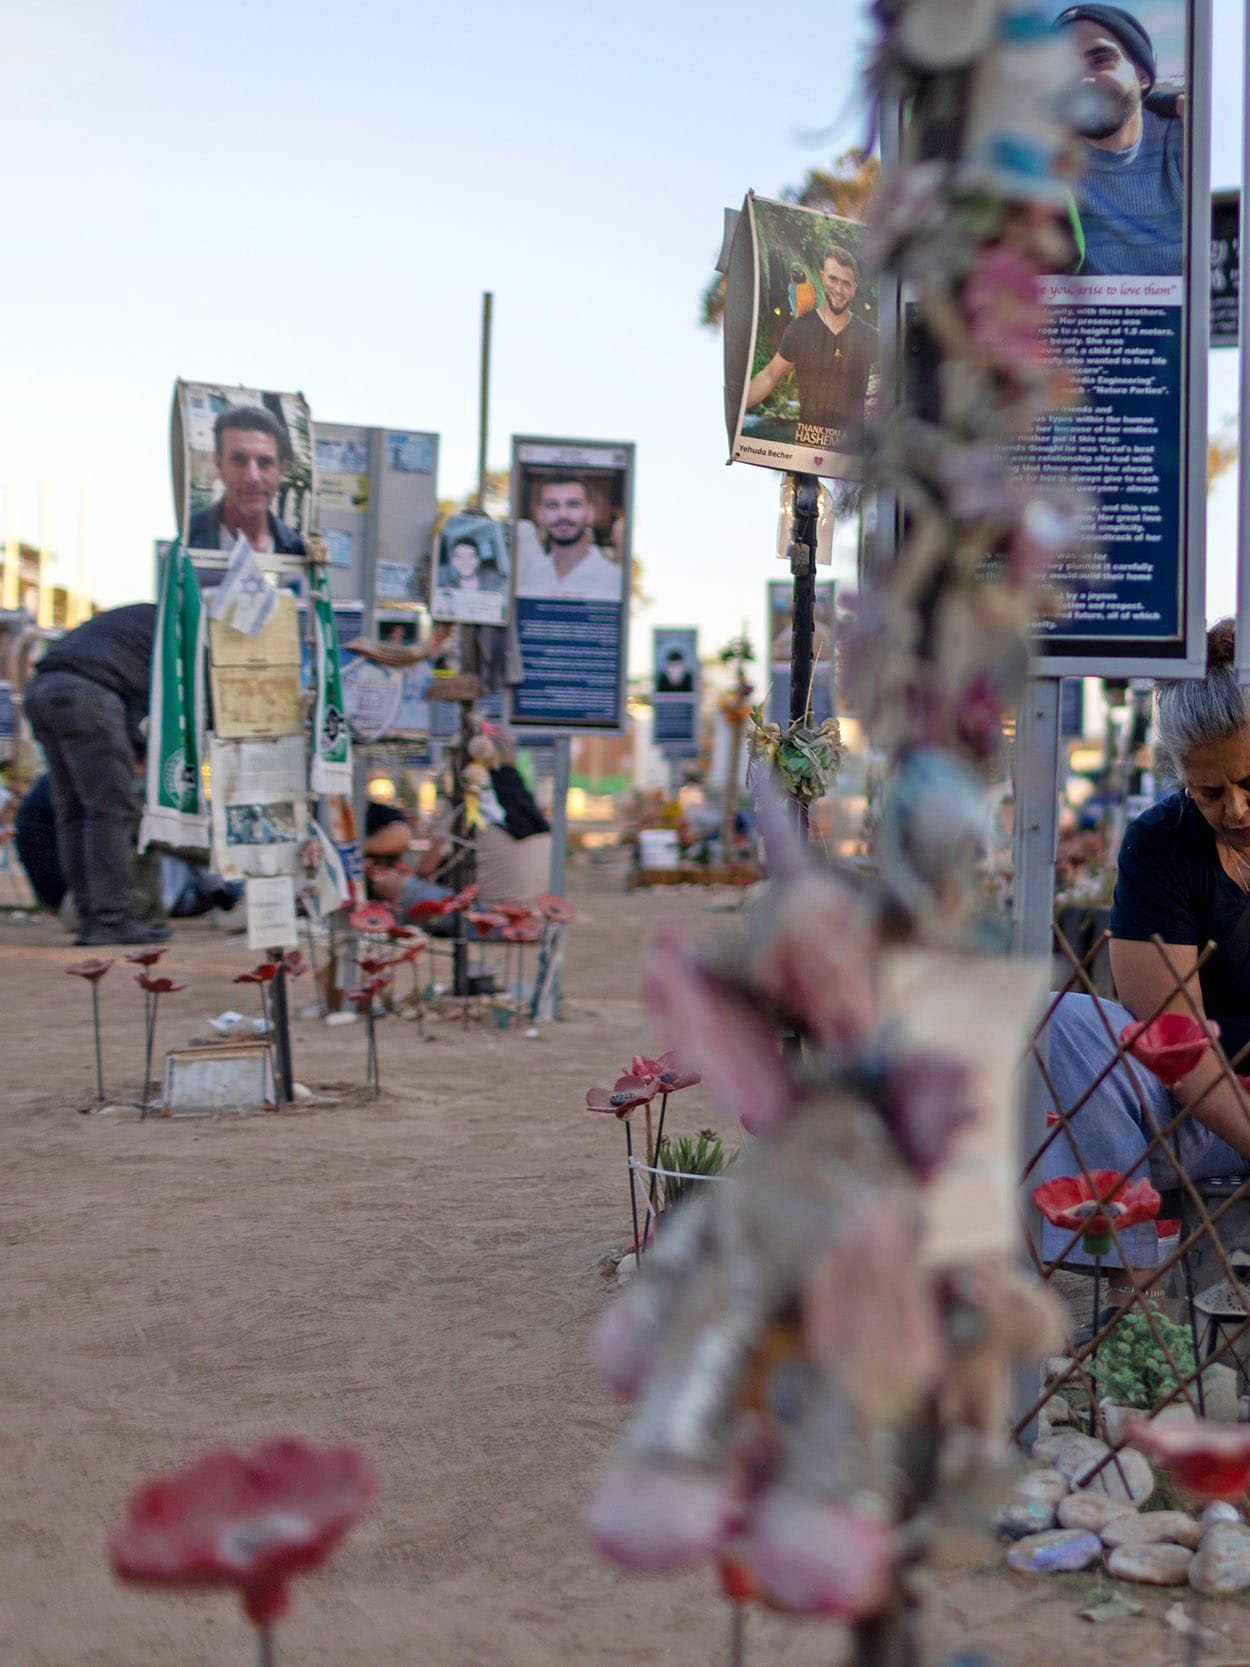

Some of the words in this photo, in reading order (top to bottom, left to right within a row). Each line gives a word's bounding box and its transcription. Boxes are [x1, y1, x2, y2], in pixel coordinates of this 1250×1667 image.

[1106, 283, 1117, 295] to
[1120, 283, 1140, 295] love
[1144, 283, 1176, 295] them"
[1076, 306, 1096, 316] with
[1098, 306, 1122, 316] three
[1124, 306, 1167, 316] brothers.
[1059, 316, 1075, 326] Her
[1077, 317, 1120, 328] presence
[1122, 318, 1141, 326] was
[1060, 326, 1070, 335] to
[1080, 326, 1109, 337] height
[1111, 326, 1121, 335] of
[1139, 326, 1175, 335] meters.
[1085, 336, 1103, 345] She
[1105, 337, 1124, 345] was
[1088, 345, 1110, 355] child
[1112, 346, 1122, 355] of
[1124, 346, 1155, 355] nature
[1086, 355, 1120, 365] wanted
[1122, 356, 1131, 365] to
[1133, 356, 1149, 365] live
[1151, 356, 1167, 365] life
[1075, 415, 1104, 424] within
[1105, 415, 1120, 424] the
[1122, 415, 1155, 424] human
[797, 422, 823, 434] THANK
[1093, 425, 1103, 434] of
[1105, 425, 1120, 434] her
[1122, 425, 1158, 434] endless
[739, 444, 766, 456] Yehuda
[767, 449, 793, 460] Becher
[1070, 463, 1102, 472] around
[1103, 464, 1119, 472] her
[1121, 464, 1154, 475] always
[1073, 610, 1105, 621] future,
[1107, 610, 1118, 619] all
[1120, 610, 1130, 620] of
[1132, 610, 1161, 620] which
